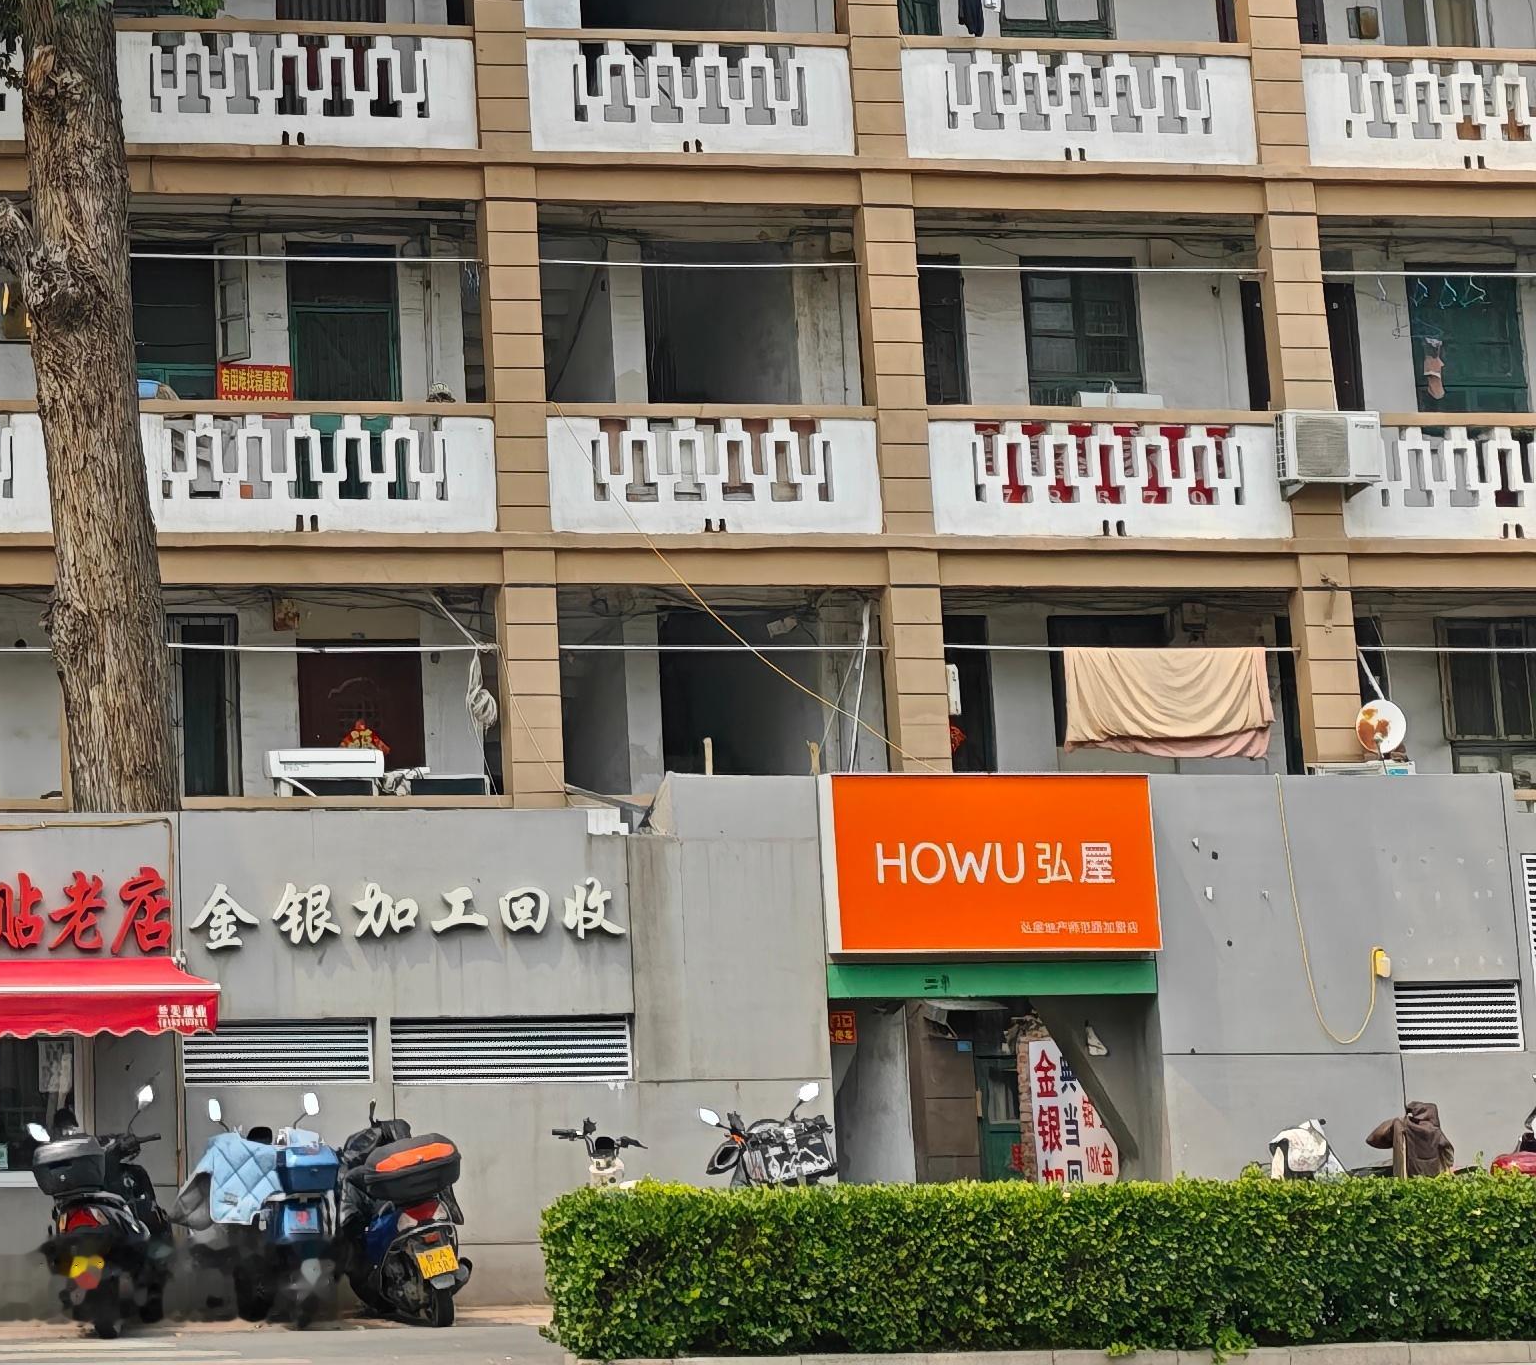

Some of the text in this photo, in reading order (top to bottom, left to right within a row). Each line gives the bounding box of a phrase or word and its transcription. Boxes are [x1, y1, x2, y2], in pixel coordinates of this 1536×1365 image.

[875, 842, 1116, 884] HOWU 弘屋
[189, 876, 627, 950] 金银加工回收
